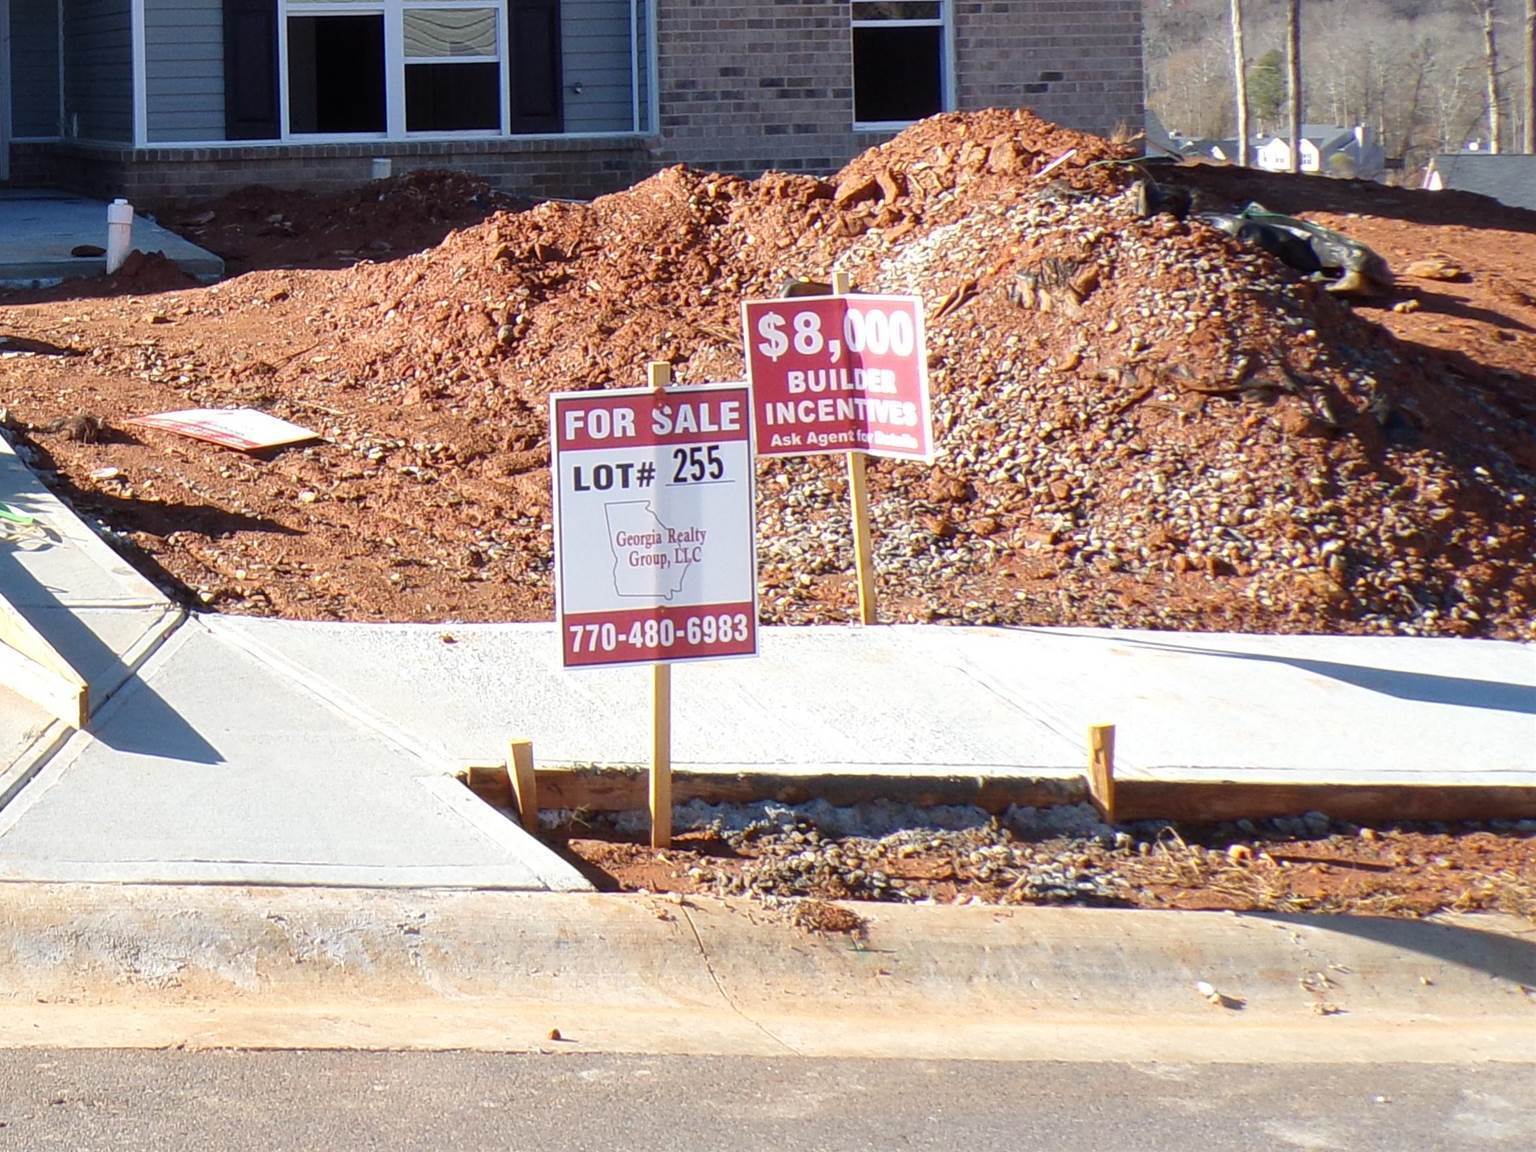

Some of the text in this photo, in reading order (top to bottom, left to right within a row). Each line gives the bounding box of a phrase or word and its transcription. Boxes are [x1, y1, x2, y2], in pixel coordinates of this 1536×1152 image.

[757, 308, 915, 364] $8,000
[787, 368, 897, 394] BUILDER
[565, 401, 741, 441] FOR SALE
[765, 398, 918, 427] INCENTIVES
[771, 433, 802, 447] Ask
[806, 430, 855, 447] Agent
[573, 445, 724, 492] LOT# 255
[616, 526, 707, 549] Georgia Realty
[628, 546, 702, 569] Group, LLC
[569, 613, 749, 653] 770-480-6983
